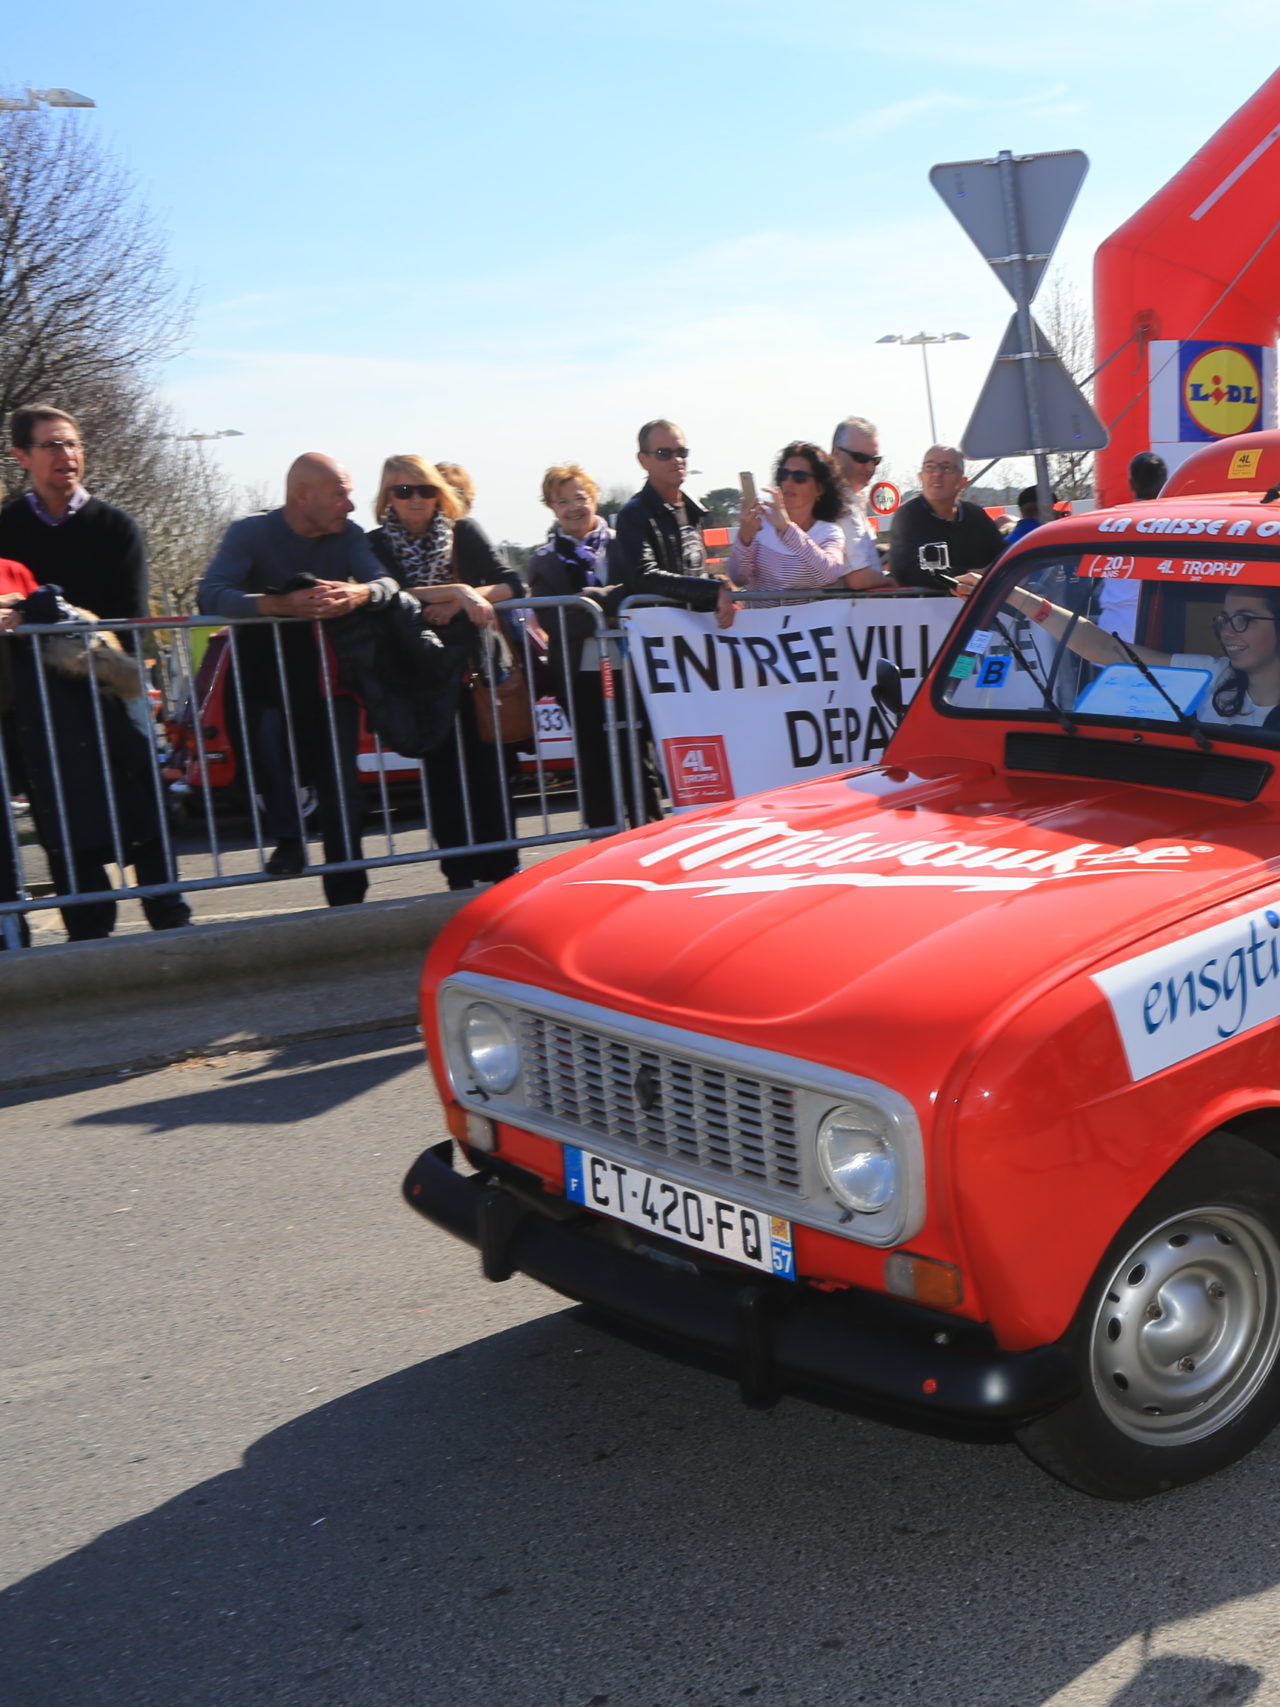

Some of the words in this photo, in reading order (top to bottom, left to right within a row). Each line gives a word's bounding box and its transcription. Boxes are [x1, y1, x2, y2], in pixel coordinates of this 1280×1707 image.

[1097, 517, 1133, 533] LA
[1135, 518, 1227, 536] CAISSE
[1226, 519, 1252, 536] A
[1104, 556, 1124, 570] 20
[1156, 560, 1175, 575] 4L
[1181, 560, 1246, 577] TROPHY
[641, 616, 839, 694] ENTRÉE
[982, 660, 1006, 685] B
[785, 690, 908, 769] DÉPA
[682, 749, 714, 772] 4L
[637, 816, 1190, 873] Milwaukee
[1143, 910, 1280, 1038] ensgti
[570, 1178, 579, 1192] F
[772, 1246, 792, 1273] 57
